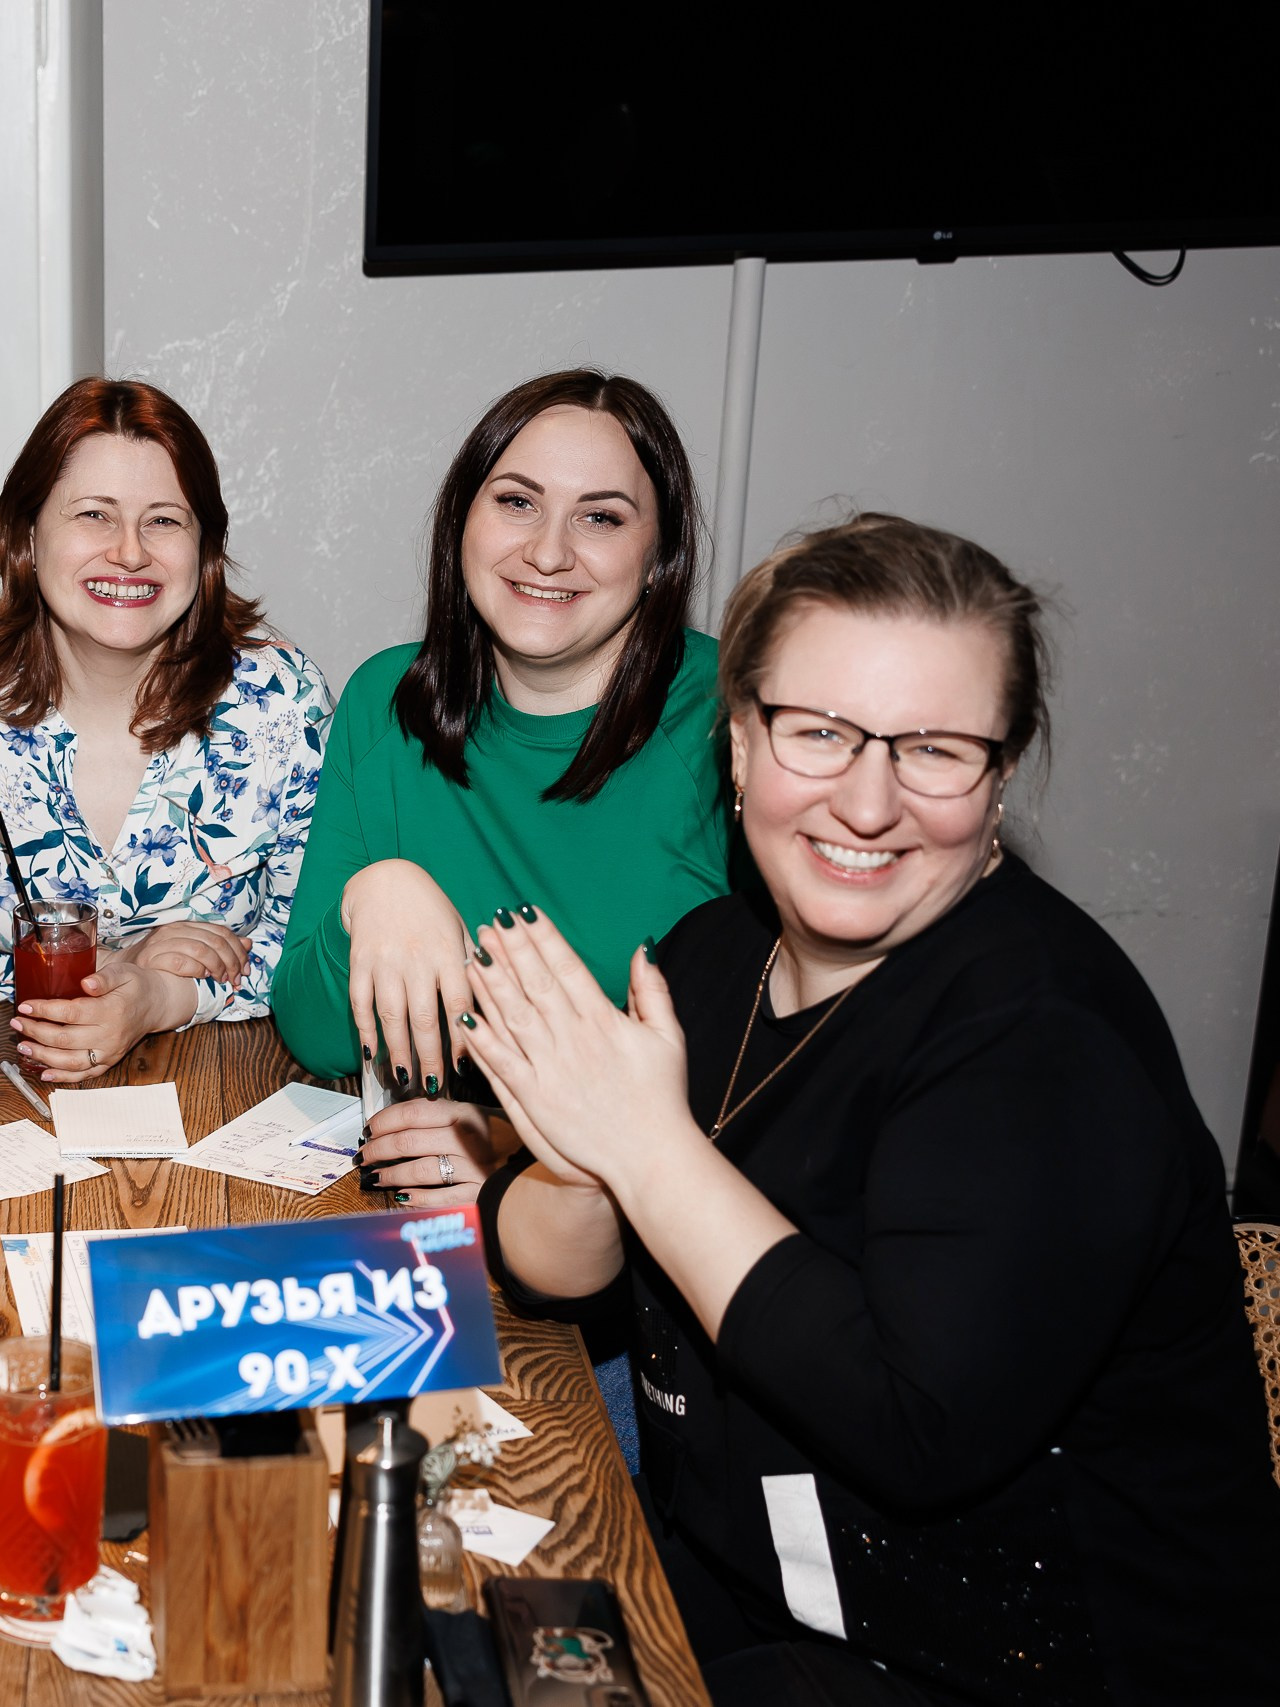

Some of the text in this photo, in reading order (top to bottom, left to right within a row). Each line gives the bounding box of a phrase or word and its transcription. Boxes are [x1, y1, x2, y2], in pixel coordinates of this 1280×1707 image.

[138, 1265, 448, 1339] ДРУЗЬЯ ИЗ
[238, 1344, 368, 1397] 90-Х
